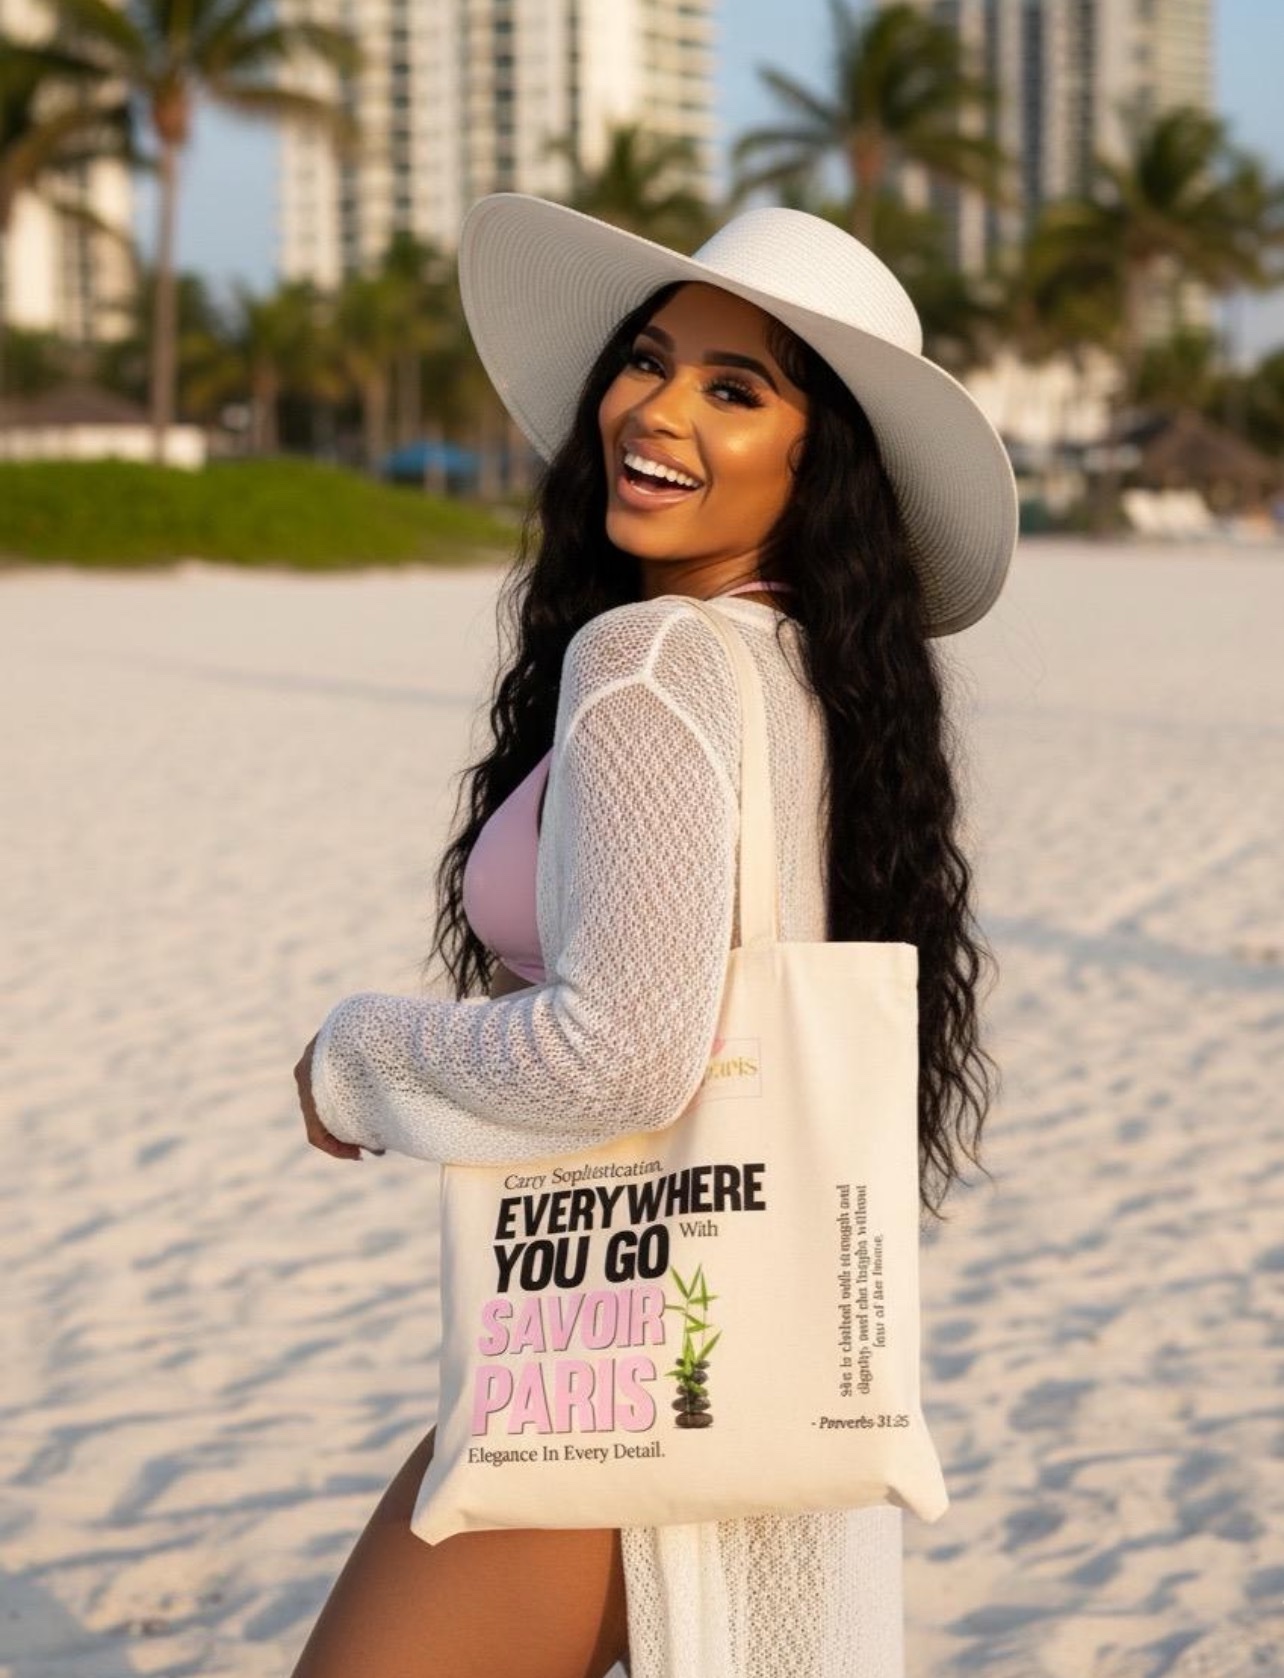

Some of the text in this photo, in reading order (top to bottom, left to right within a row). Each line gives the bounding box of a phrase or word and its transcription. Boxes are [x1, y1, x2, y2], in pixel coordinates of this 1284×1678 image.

[706, 1056, 758, 1078] aris
[495, 1163, 766, 1240] EVERYWHERE
[504, 1174, 547, 1191] Carry
[679, 1219, 719, 1239] With
[493, 1223, 670, 1293] YOU GO
[477, 1285, 667, 1356] SAVOIR
[471, 1355, 657, 1436] PARIS
[468, 1441, 666, 1467] Elegance In Every Detail.
